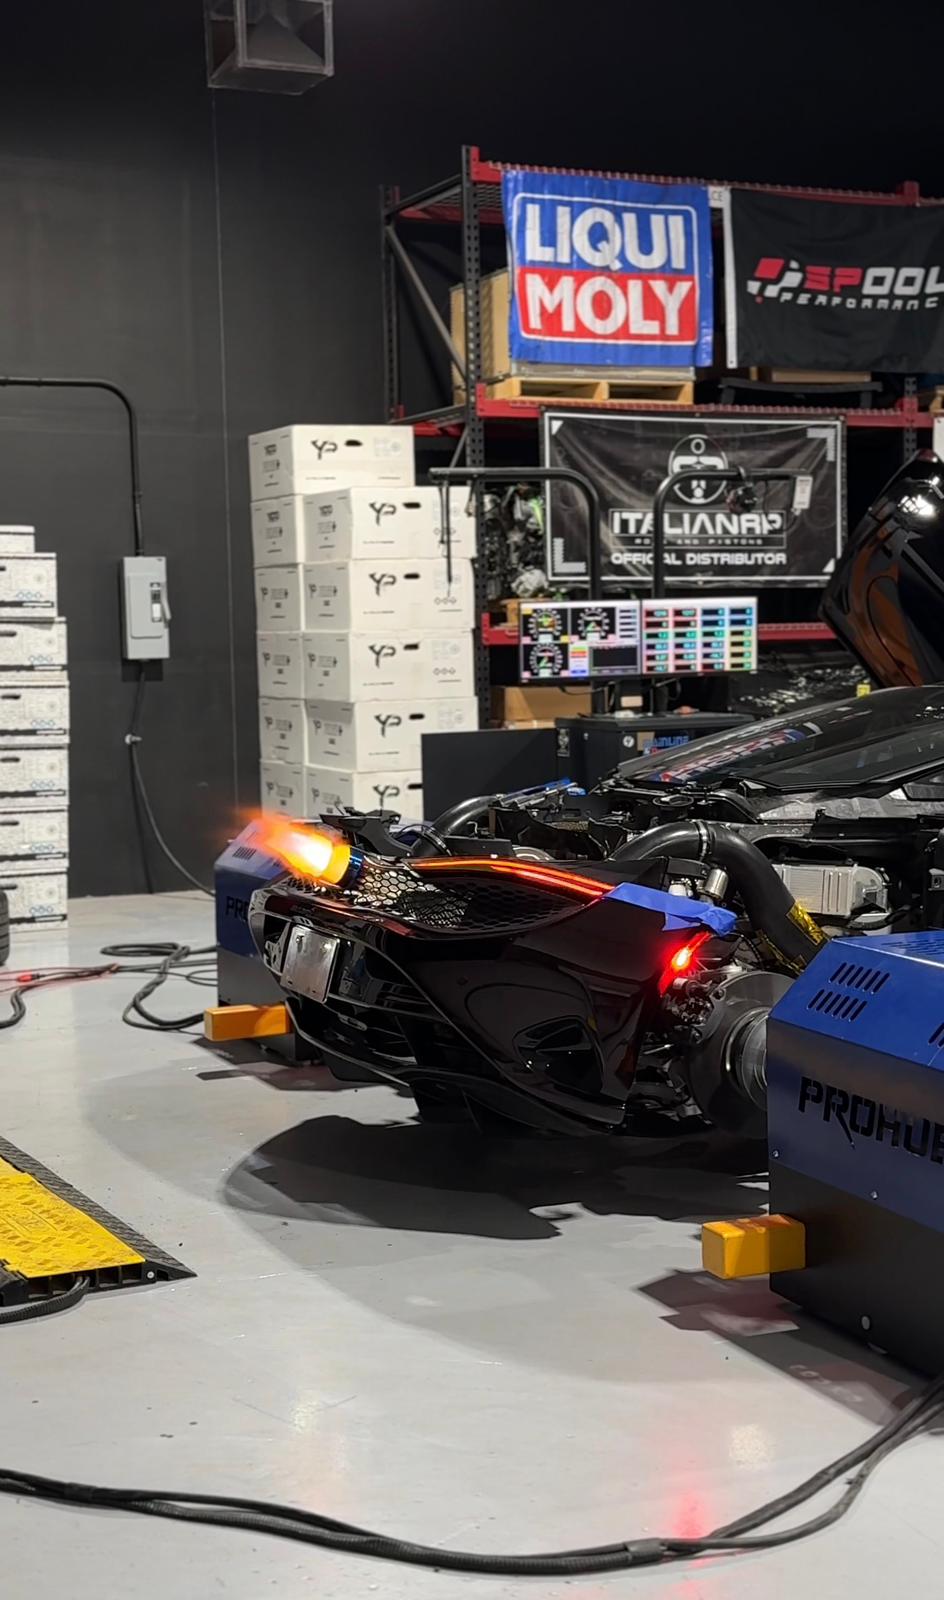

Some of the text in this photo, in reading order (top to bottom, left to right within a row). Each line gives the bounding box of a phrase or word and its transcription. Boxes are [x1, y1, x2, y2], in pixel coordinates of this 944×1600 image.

[525, 203, 687, 271] LIQUI
[804, 264, 944, 295] SPOOL
[524, 272, 693, 336] MOLY
[610, 552, 788, 566] OFFICAL DISTRIBUTOR
